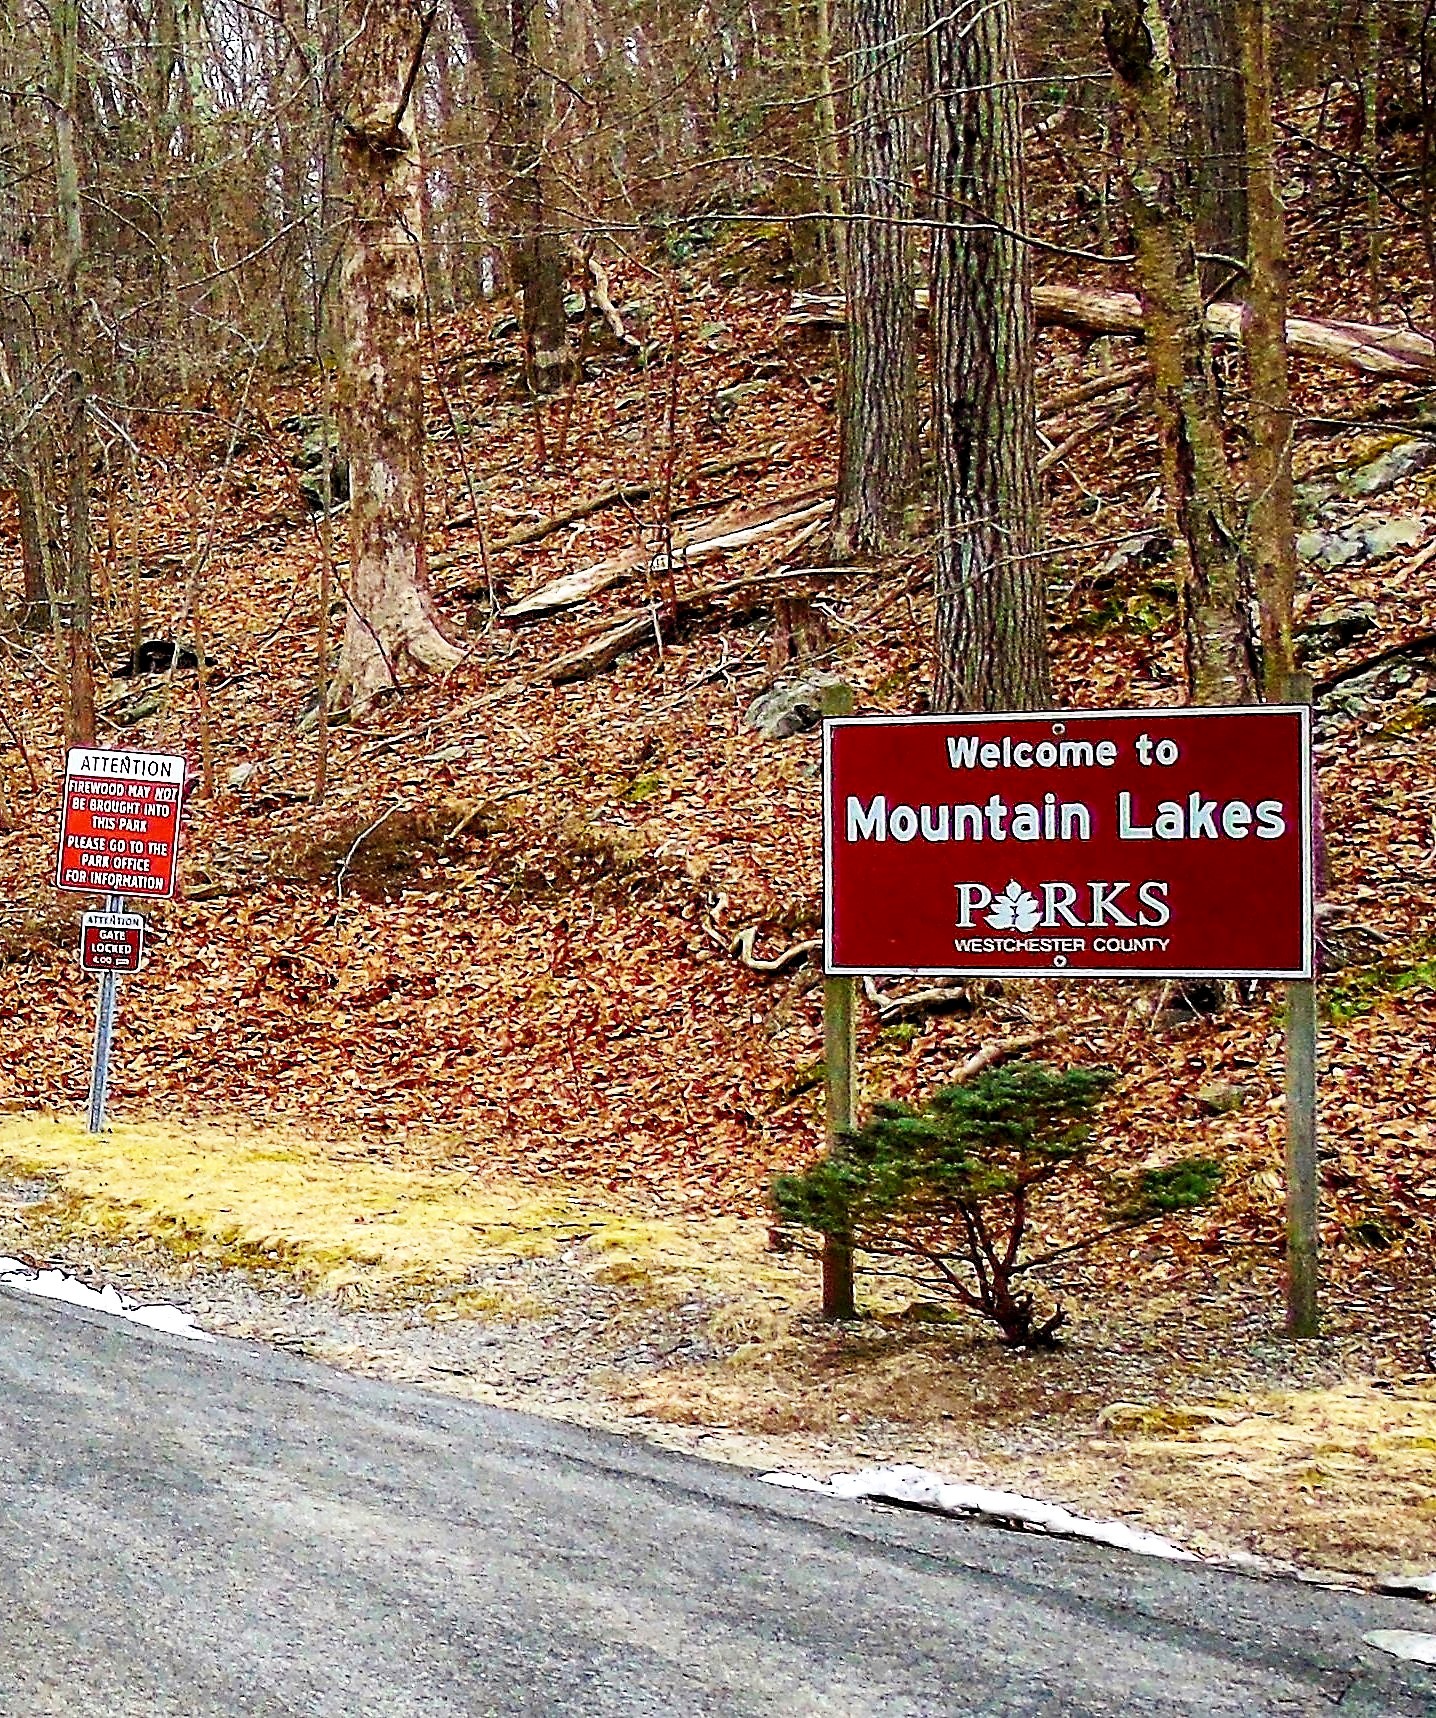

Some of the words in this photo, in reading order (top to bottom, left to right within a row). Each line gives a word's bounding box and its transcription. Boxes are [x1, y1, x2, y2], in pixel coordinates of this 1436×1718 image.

[946, 735, 1118, 769] Welcome
[1135, 733, 1179, 767] to
[81, 755, 172, 777] ATTENTION
[68, 779, 125, 797] FIREWOOD
[127, 784, 151, 799] MAY
[154, 787, 179, 802] NOT
[72, 797, 87, 811] BE
[89, 798, 141, 815] BROUGHT
[143, 803, 170, 817] INTO
[846, 792, 1091, 842] Mountain
[1119, 791, 1287, 840] Lakes
[92, 815, 115, 830] THIS
[118, 818, 147, 833] PARK
[67, 835, 106, 851] PLEASE
[109, 838, 126, 853] GO
[130, 840, 144, 854] TO
[148, 842, 168, 856] THE
[81, 853, 110, 868] PARK
[113, 856, 150, 872] OFFICE
[65, 869, 87, 883] FOR
[90, 871, 164, 890] INFORMATION
[87, 914, 139, 927] ATTENTION
[99, 929, 126, 941] GATE
[954, 938, 1085, 953] WESTCHESTER
[1093, 937, 1170, 953] COUNTY
[91, 942, 132, 955] LOCKED
